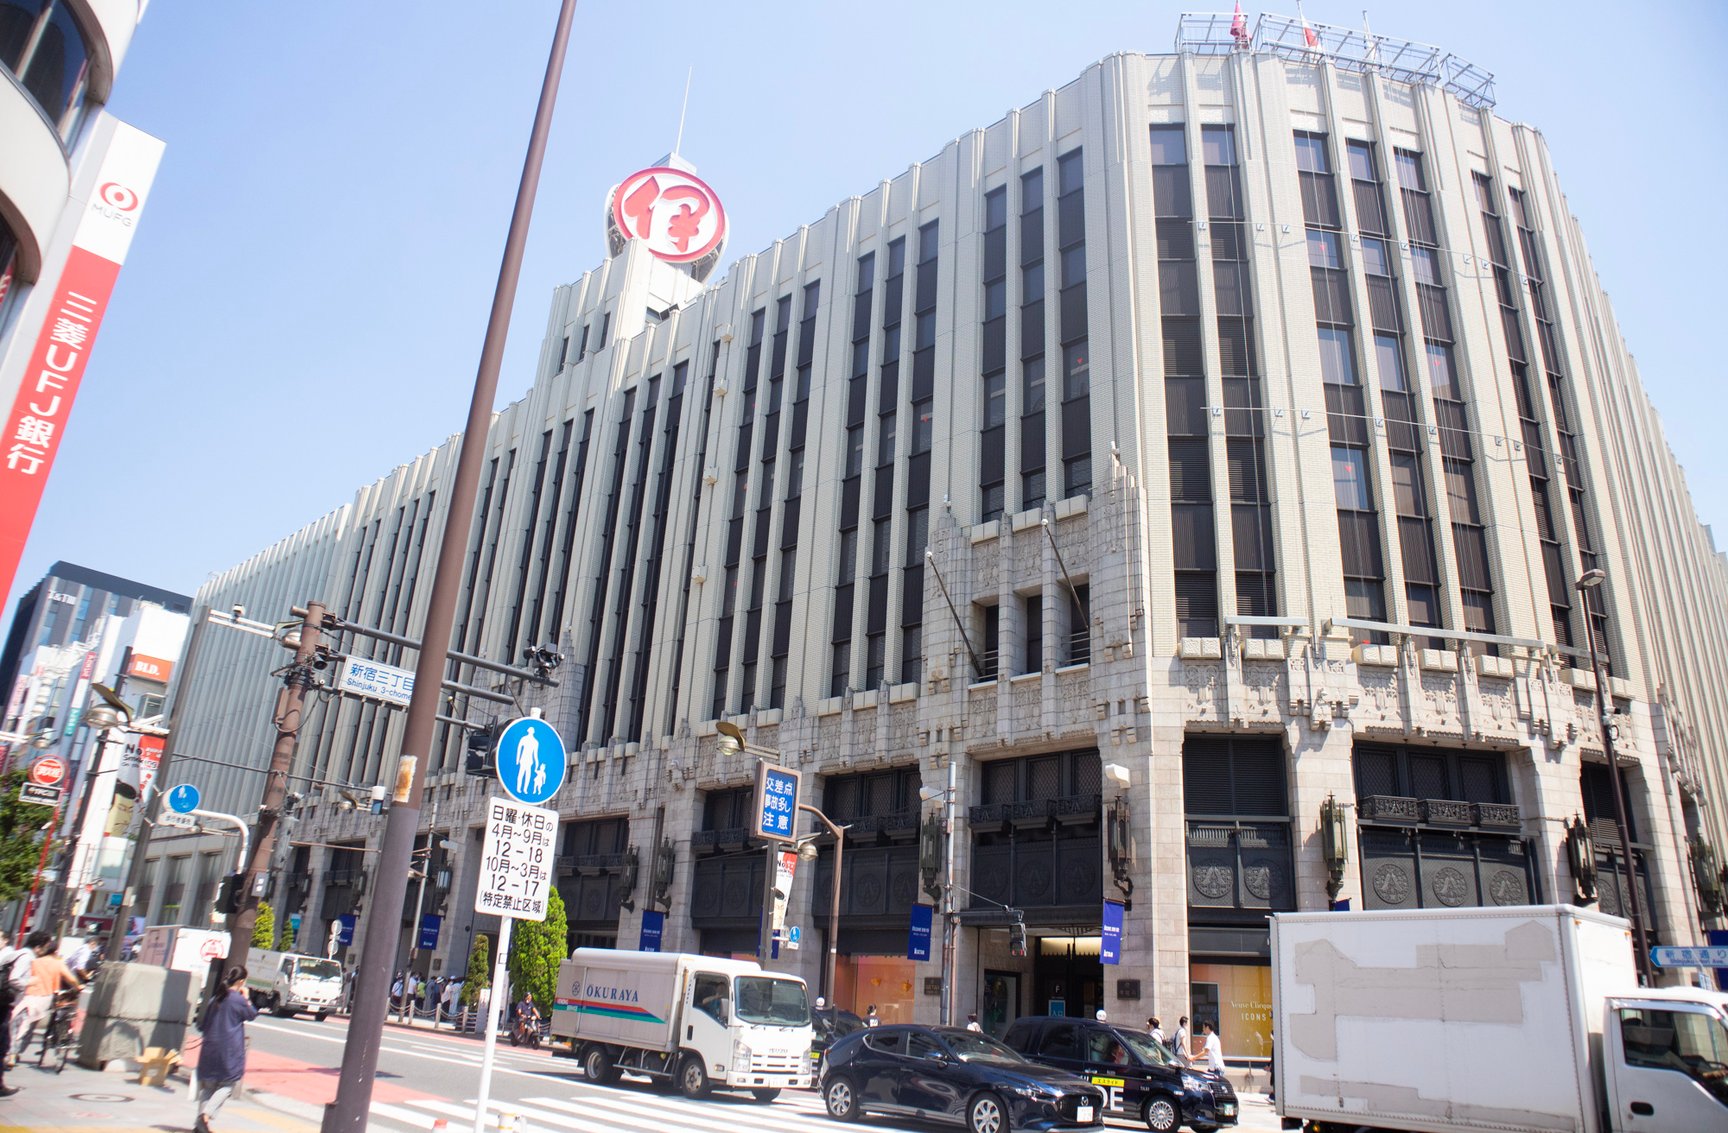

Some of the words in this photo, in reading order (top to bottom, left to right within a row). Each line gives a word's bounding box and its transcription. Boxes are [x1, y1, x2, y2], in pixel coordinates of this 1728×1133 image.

[90, 203, 132, 227] MUFG
[6, 291, 98, 475] 三菱UFJ銀行
[135, 661, 160, 676] BLD.
[350, 663, 415, 692] 新宿三丁目
[347, 677, 378, 693] Shinjuku
[125, 743, 144, 756] No
[766, 777, 793, 796] 交差点
[492, 805, 554, 832] 日曜・休日の
[763, 812, 788, 830] 注意
[586, 984, 639, 1002] OKURAYA
[1241, 1012, 1267, 1021] ICONS
